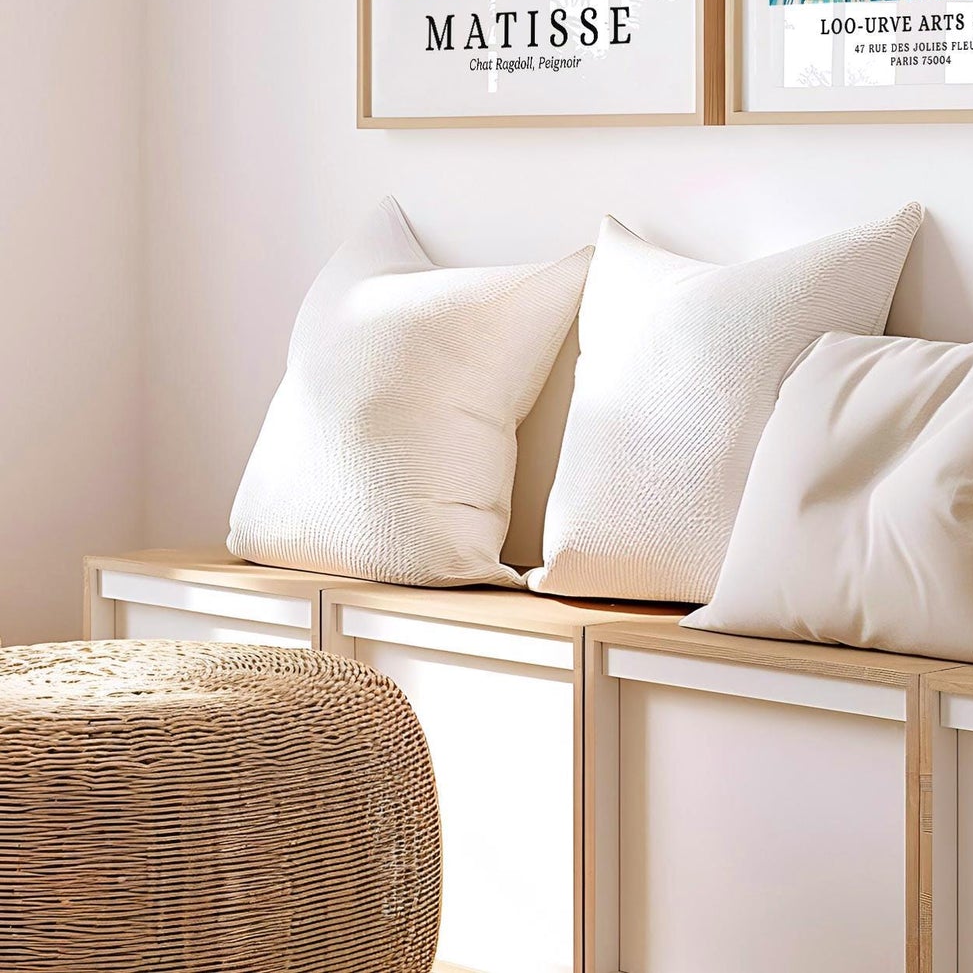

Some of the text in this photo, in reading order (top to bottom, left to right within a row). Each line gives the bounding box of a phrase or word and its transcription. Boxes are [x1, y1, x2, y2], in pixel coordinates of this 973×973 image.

[425, 6, 631, 51] MATISSE
[820, 16, 912, 35] LOO-URVE
[918, 14, 965, 32] ARTS
[854, 44, 866, 54] 47
[868, 43, 887, 53] RUE
[891, 42, 910, 53] DES
[913, 41, 948, 52] JOLIES
[469, 56, 582, 74] Chat Ragdoll, Peignoir
[890, 55, 951, 66] PARIS 75004
